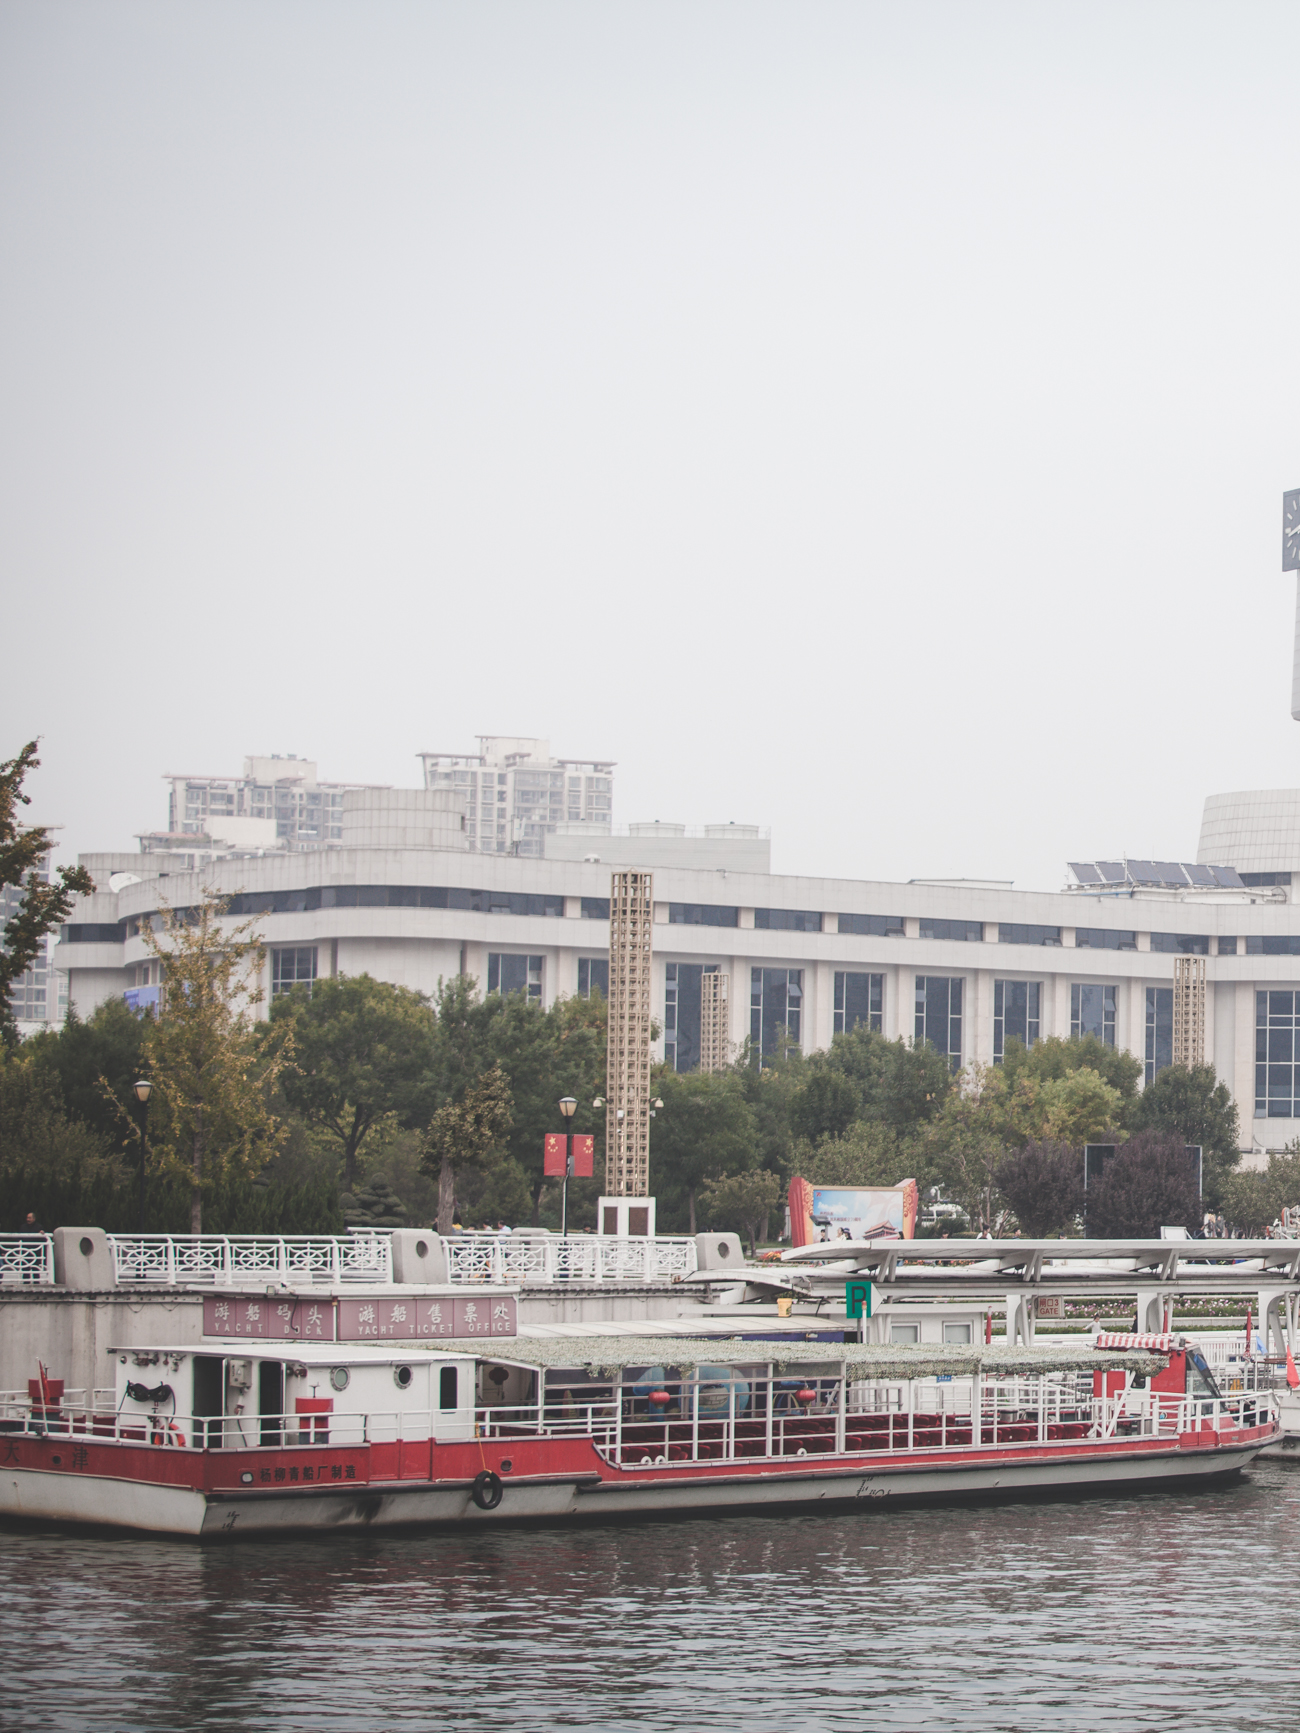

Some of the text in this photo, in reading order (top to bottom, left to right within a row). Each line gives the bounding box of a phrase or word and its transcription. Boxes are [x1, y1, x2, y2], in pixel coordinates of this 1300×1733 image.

[851, 1286, 867, 1314] P
[214, 1302, 323, 1326] 游船码头
[358, 1302, 510, 1324] 游船售票处
[1040, 1307, 1059, 1315] GATE
[214, 1322, 323, 1336] YACHT DOCK
[358, 1322, 511, 1336] YACHT TICKET OFFICE
[3, 1440, 90, 1471] 天津
[260, 1464, 356, 1482] 杨柳青船厂制造
